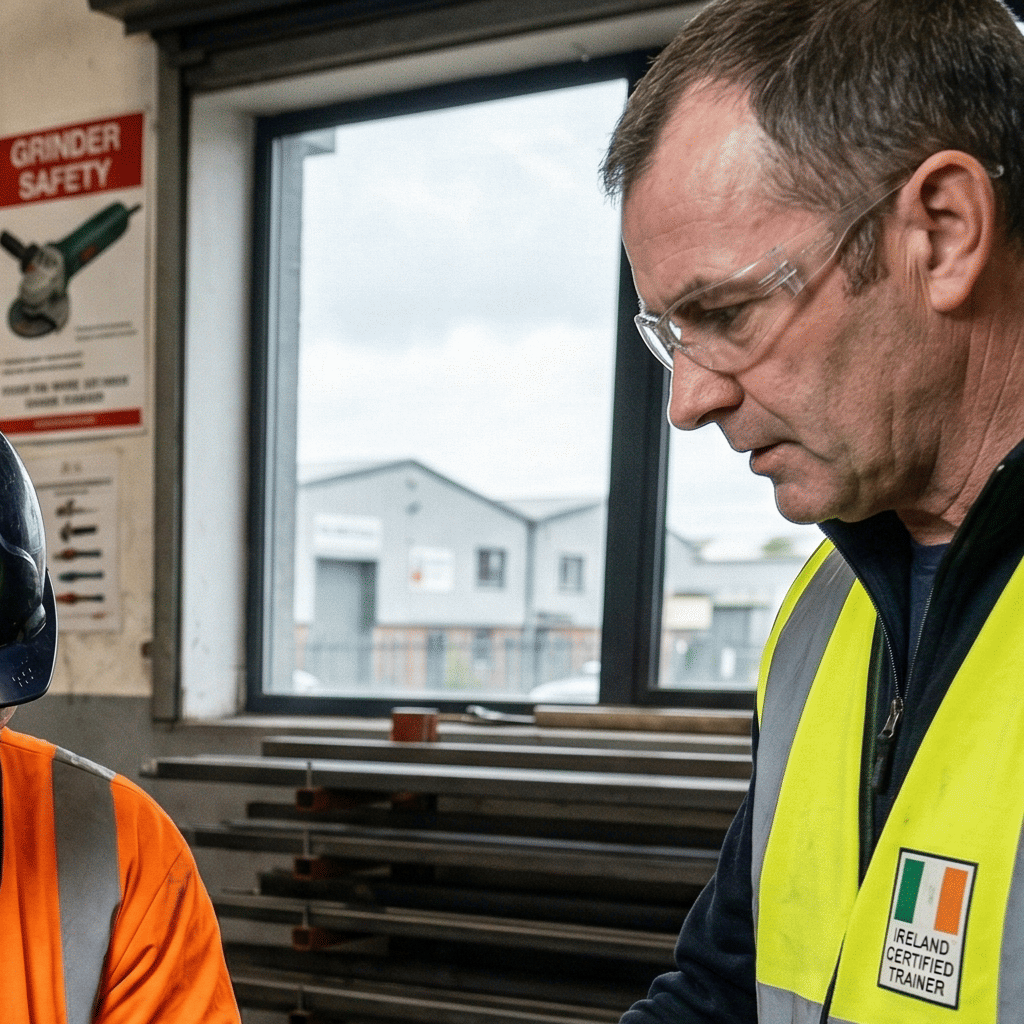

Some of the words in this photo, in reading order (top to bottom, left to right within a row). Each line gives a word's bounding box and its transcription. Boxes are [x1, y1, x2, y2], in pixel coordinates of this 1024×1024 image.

[18, 157, 113, 200] SAFETY
[893, 927, 950, 955] IRELAND
[886, 946, 954, 978] CERTIFIED
[889, 966, 945, 997] TRAINER
